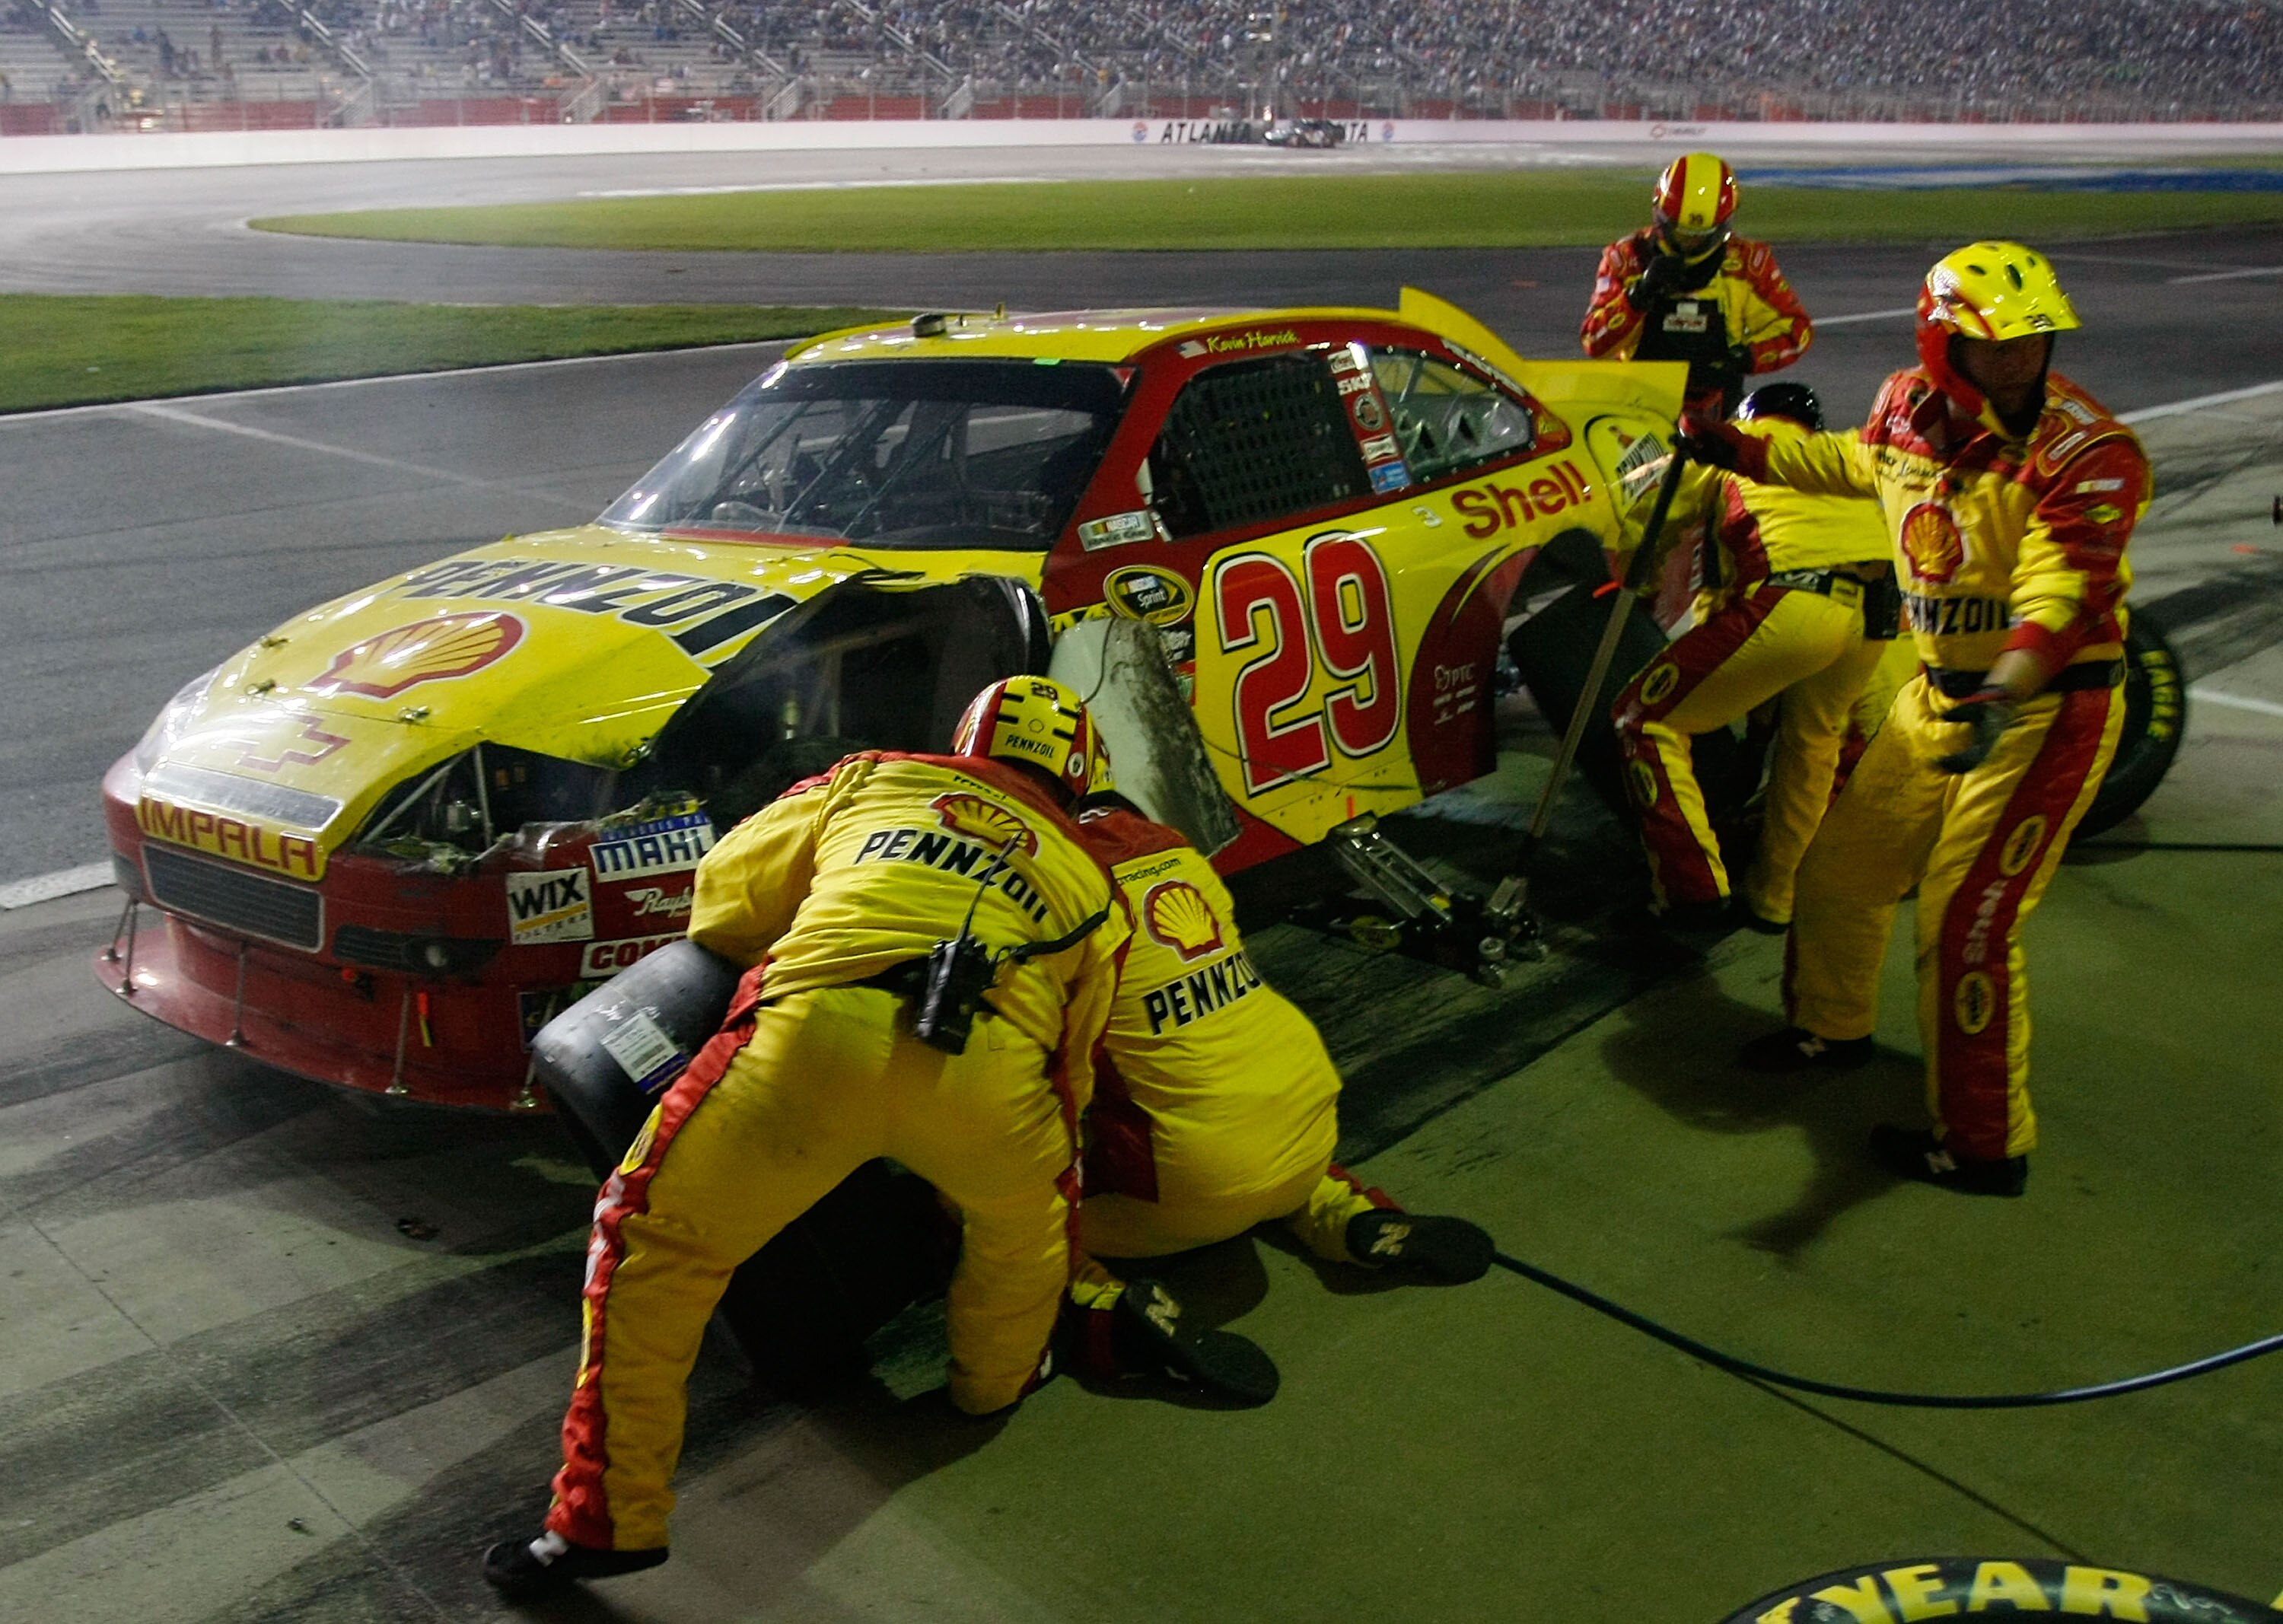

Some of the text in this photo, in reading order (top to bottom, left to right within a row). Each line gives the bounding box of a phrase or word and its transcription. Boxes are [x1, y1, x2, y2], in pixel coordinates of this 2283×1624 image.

[1450, 459, 1592, 540] Shell
[1137, 588, 1167, 608] Sprint
[1030, 681, 1059, 701] 29
[1214, 530, 1403, 798] 29
[1005, 734, 1055, 759] PENNZOIL
[139, 794, 317, 876] IMPALA
[508, 871, 584, 920] WIX
[854, 829, 1049, 924] PENNZOIL
